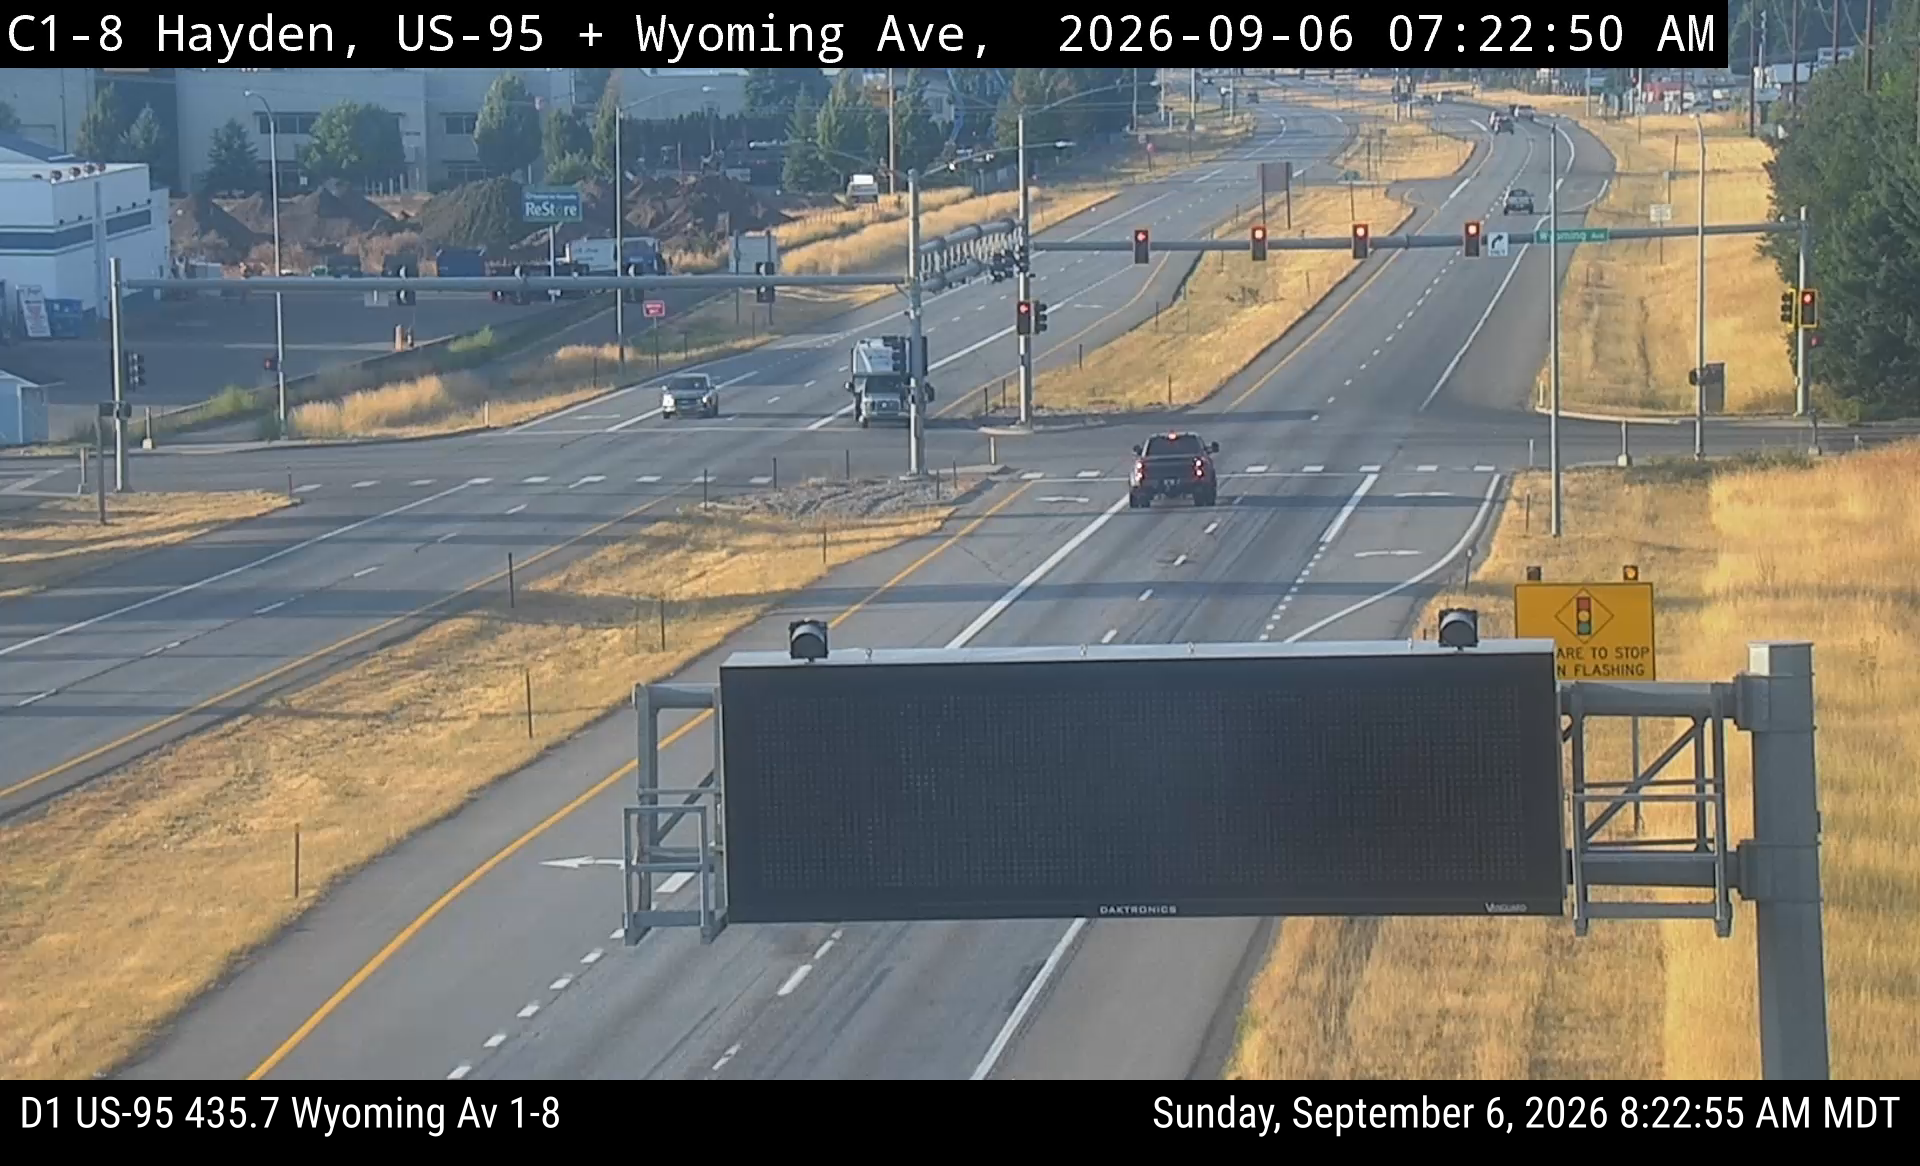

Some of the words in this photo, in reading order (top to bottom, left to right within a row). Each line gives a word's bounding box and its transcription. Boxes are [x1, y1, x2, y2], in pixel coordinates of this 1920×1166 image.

[1539, 231, 1587, 242] Woming
[1591, 646, 1608, 660] TO
[1615, 646, 1650, 660] STOP
[1574, 663, 1645, 677] FLASHING
[1100, 904, 1178, 915] DAKTRONICS
